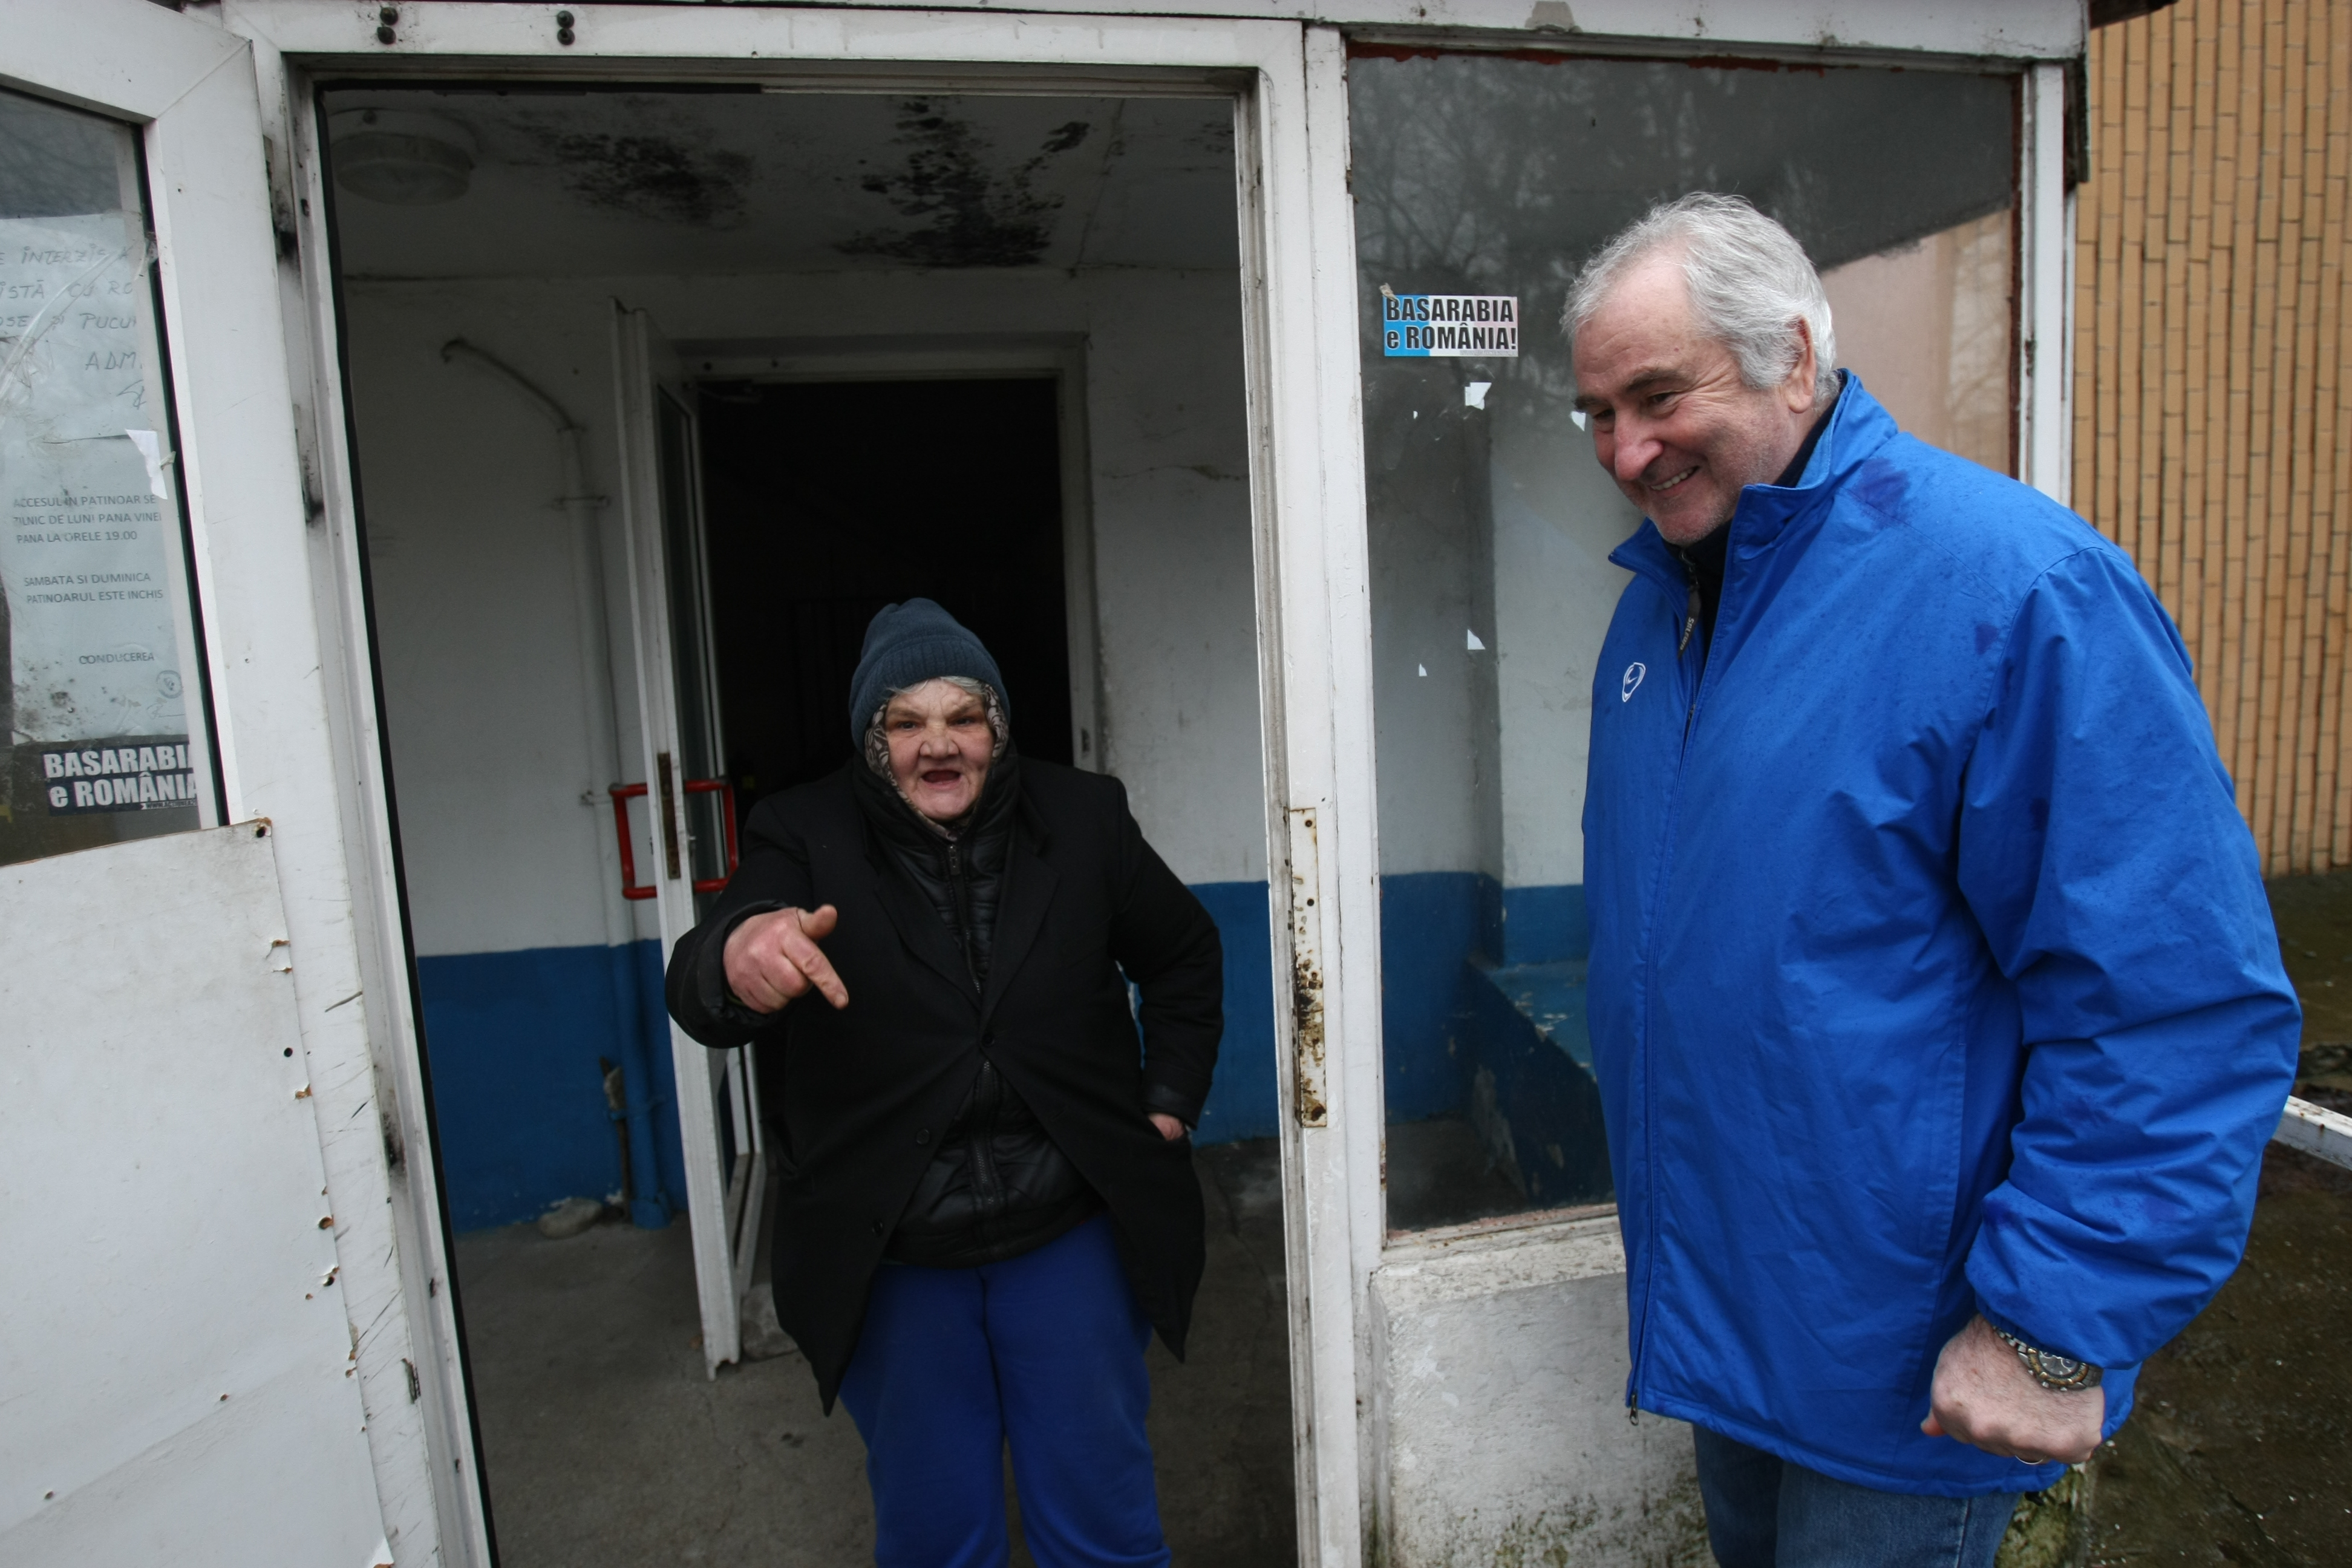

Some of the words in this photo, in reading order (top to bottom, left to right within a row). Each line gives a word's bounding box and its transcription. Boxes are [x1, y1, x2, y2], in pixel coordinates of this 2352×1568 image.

[1386, 297, 1514, 322] BASARABIA
[1387, 330, 1400, 349] e
[1405, 322, 1517, 350] ROMÂNIA!
[81, 495, 141, 506] PATINOAR
[143, 494, 156, 504] SE
[49, 514, 64, 524] DE
[67, 514, 95, 524] LUNI
[99, 513, 132, 523] PANA
[16, 534, 45, 544] PANA
[47, 533, 61, 543] LA
[64, 532, 102, 542] ORELE
[106, 531, 137, 541] 19.00
[24, 575, 74, 587] SAMBATA
[77, 574, 89, 584] SI
[91, 572, 151, 584] DUMINICA
[27, 592, 96, 604] PATINOARUL
[99, 590, 125, 601] ESTE
[128, 589, 163, 599] INCHIS
[79, 652, 155, 665] CONDUCEREA
[49, 786, 69, 808] e
